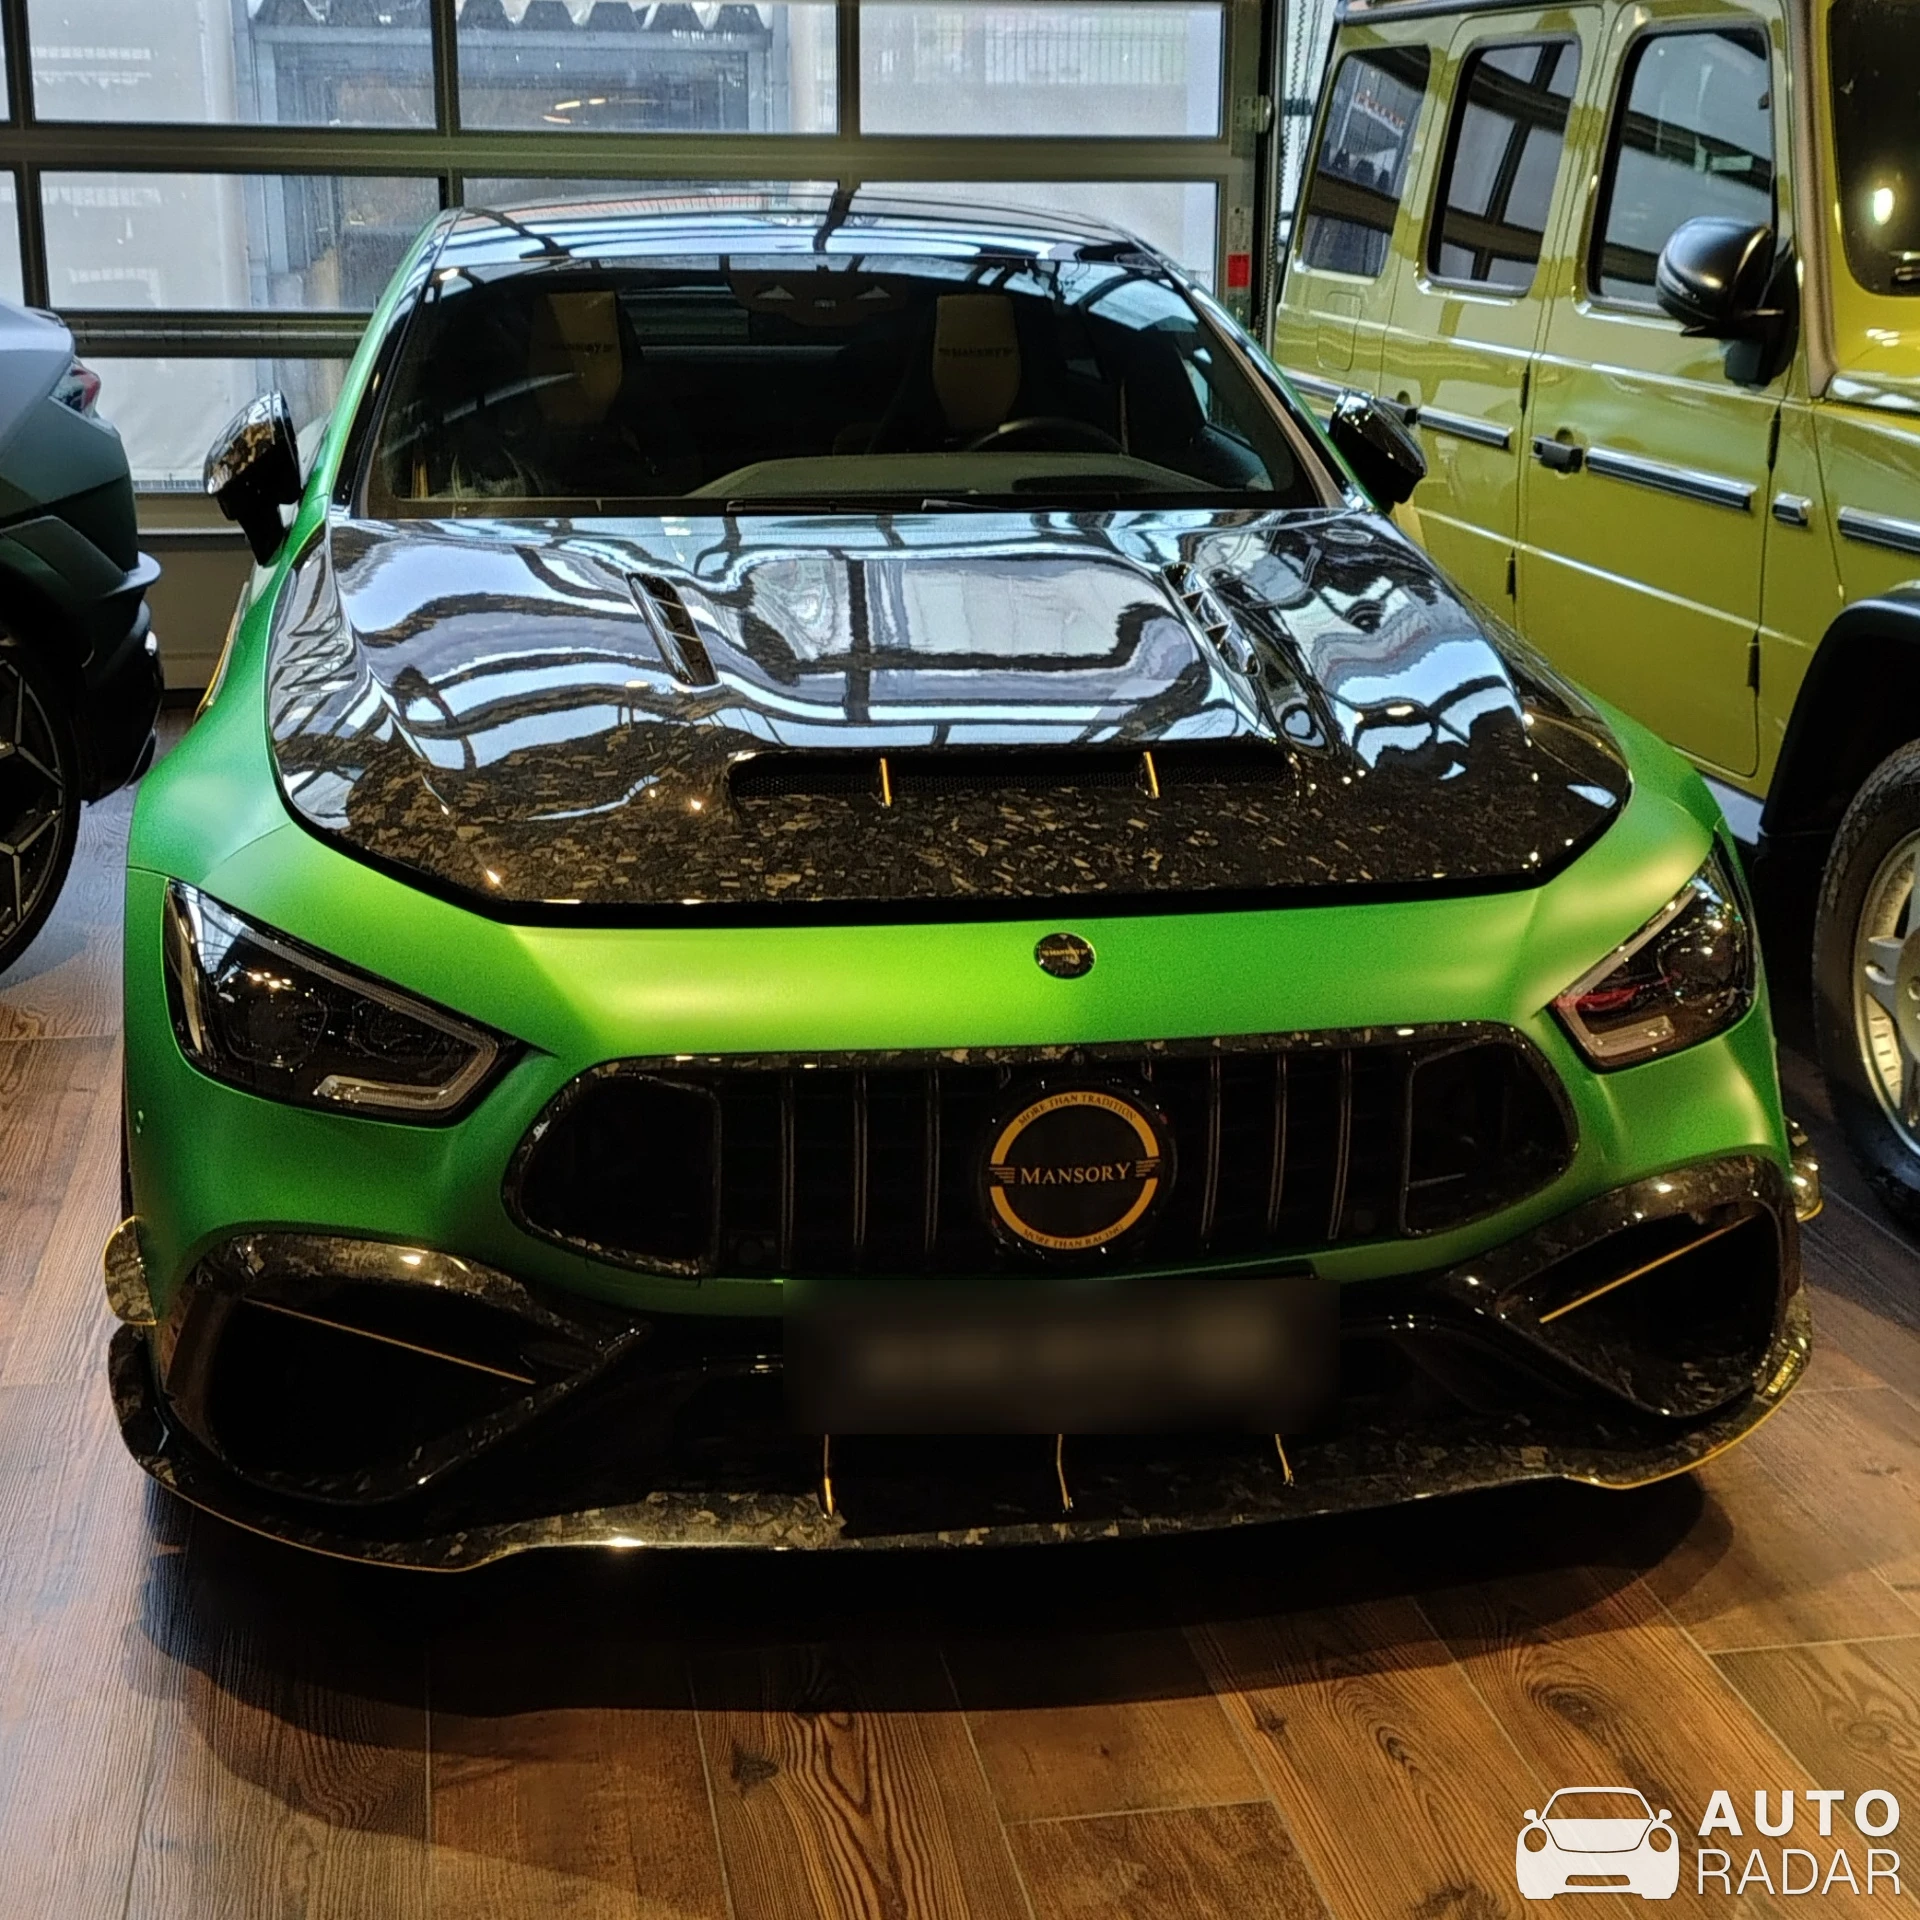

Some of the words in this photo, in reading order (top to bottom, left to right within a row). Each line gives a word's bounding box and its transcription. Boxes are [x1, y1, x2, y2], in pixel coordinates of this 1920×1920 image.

[1018, 1104, 1045, 1126] MORE
[1049, 1094, 1078, 1108] THAN
[1081, 1094, 1137, 1121] TRADITION
[1021, 1162, 1131, 1185] MANSORY
[1053, 1239, 1082, 1248] THAN
[1085, 1224, 1124, 1246] RACING
